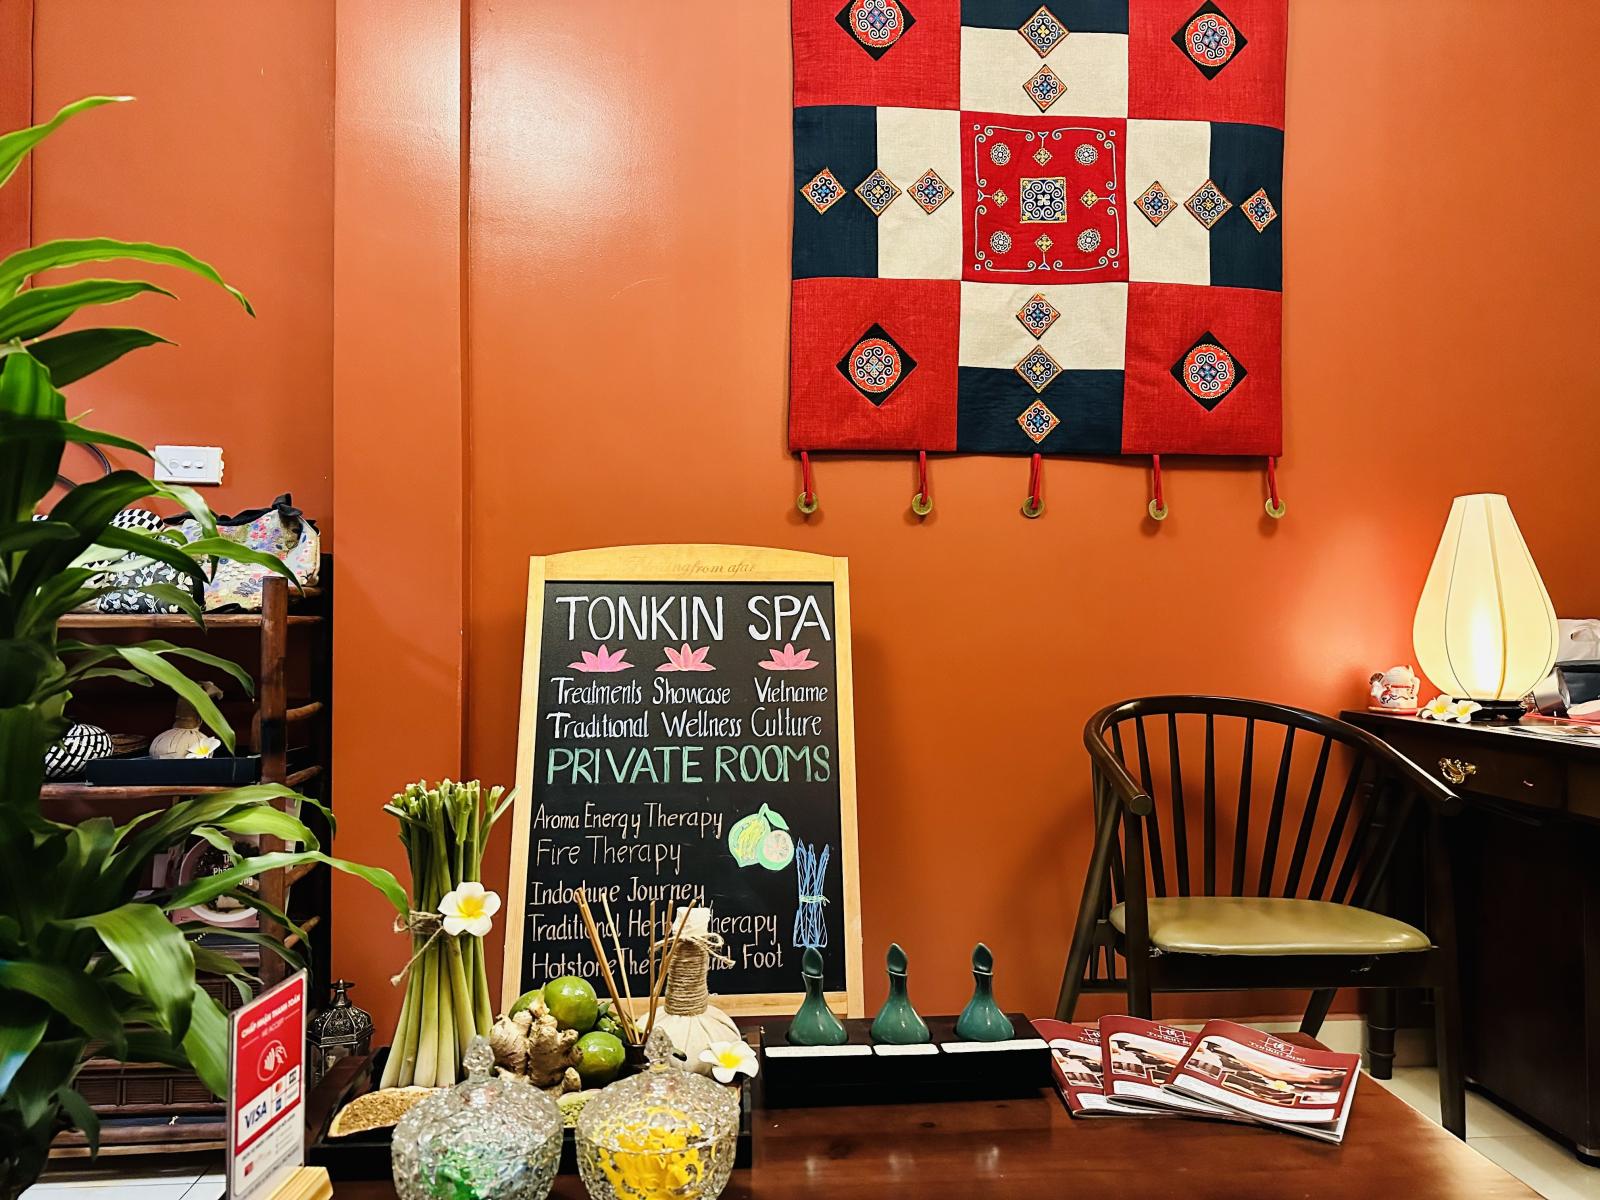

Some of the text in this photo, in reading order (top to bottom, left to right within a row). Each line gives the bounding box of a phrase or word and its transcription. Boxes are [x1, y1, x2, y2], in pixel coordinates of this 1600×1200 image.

[555, 594, 832, 641] TONKIN SPA
[550, 676, 829, 706] Treatments Showcase Vietname
[546, 707, 823, 739] Traditional Wellness Culture
[547, 744, 831, 785] PRIVATE ROOMS
[533, 801, 723, 839] Aroma Energy Therapy
[536, 835, 682, 875] Fire Therapy
[529, 876, 706, 907] Indochine Journey
[710, 914, 777, 946] herapy
[707, 951, 736, 971] nd
[742, 943, 784, 970] Foot
[244, 1101, 267, 1129] VISA
